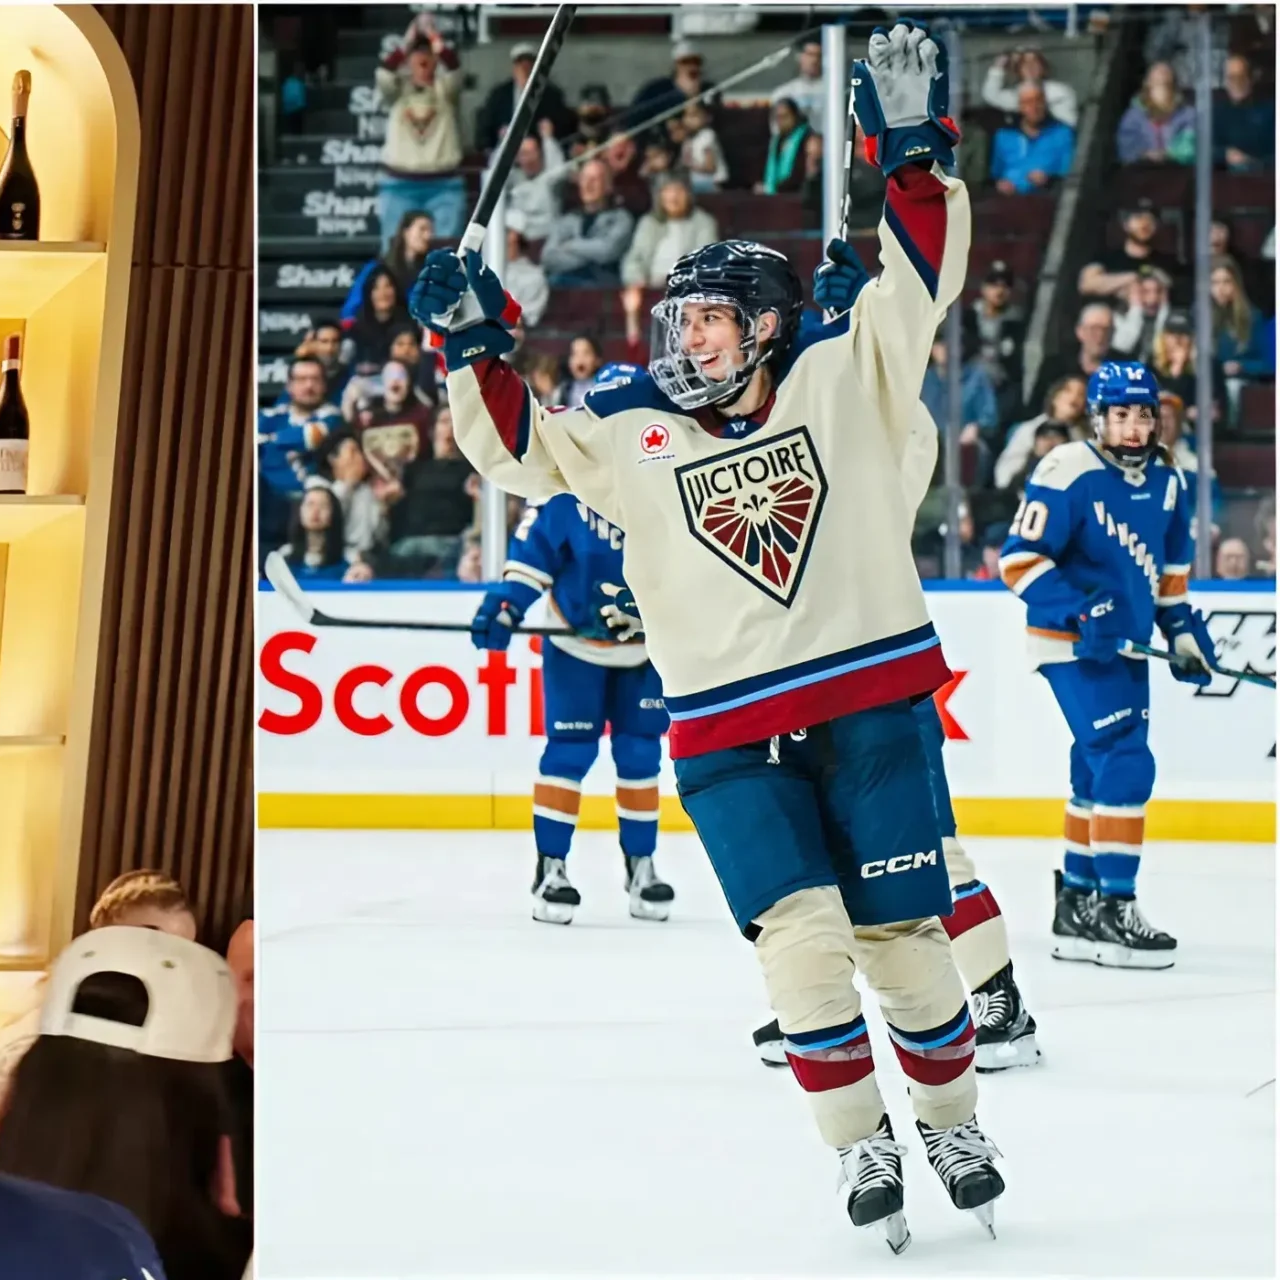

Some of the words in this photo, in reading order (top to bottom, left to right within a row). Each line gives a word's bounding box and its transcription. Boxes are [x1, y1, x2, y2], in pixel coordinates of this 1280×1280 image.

[276, 263, 356, 288] Shark
[686, 440, 814, 518] VICTOIRE
[860, 850, 937, 879] CCM
